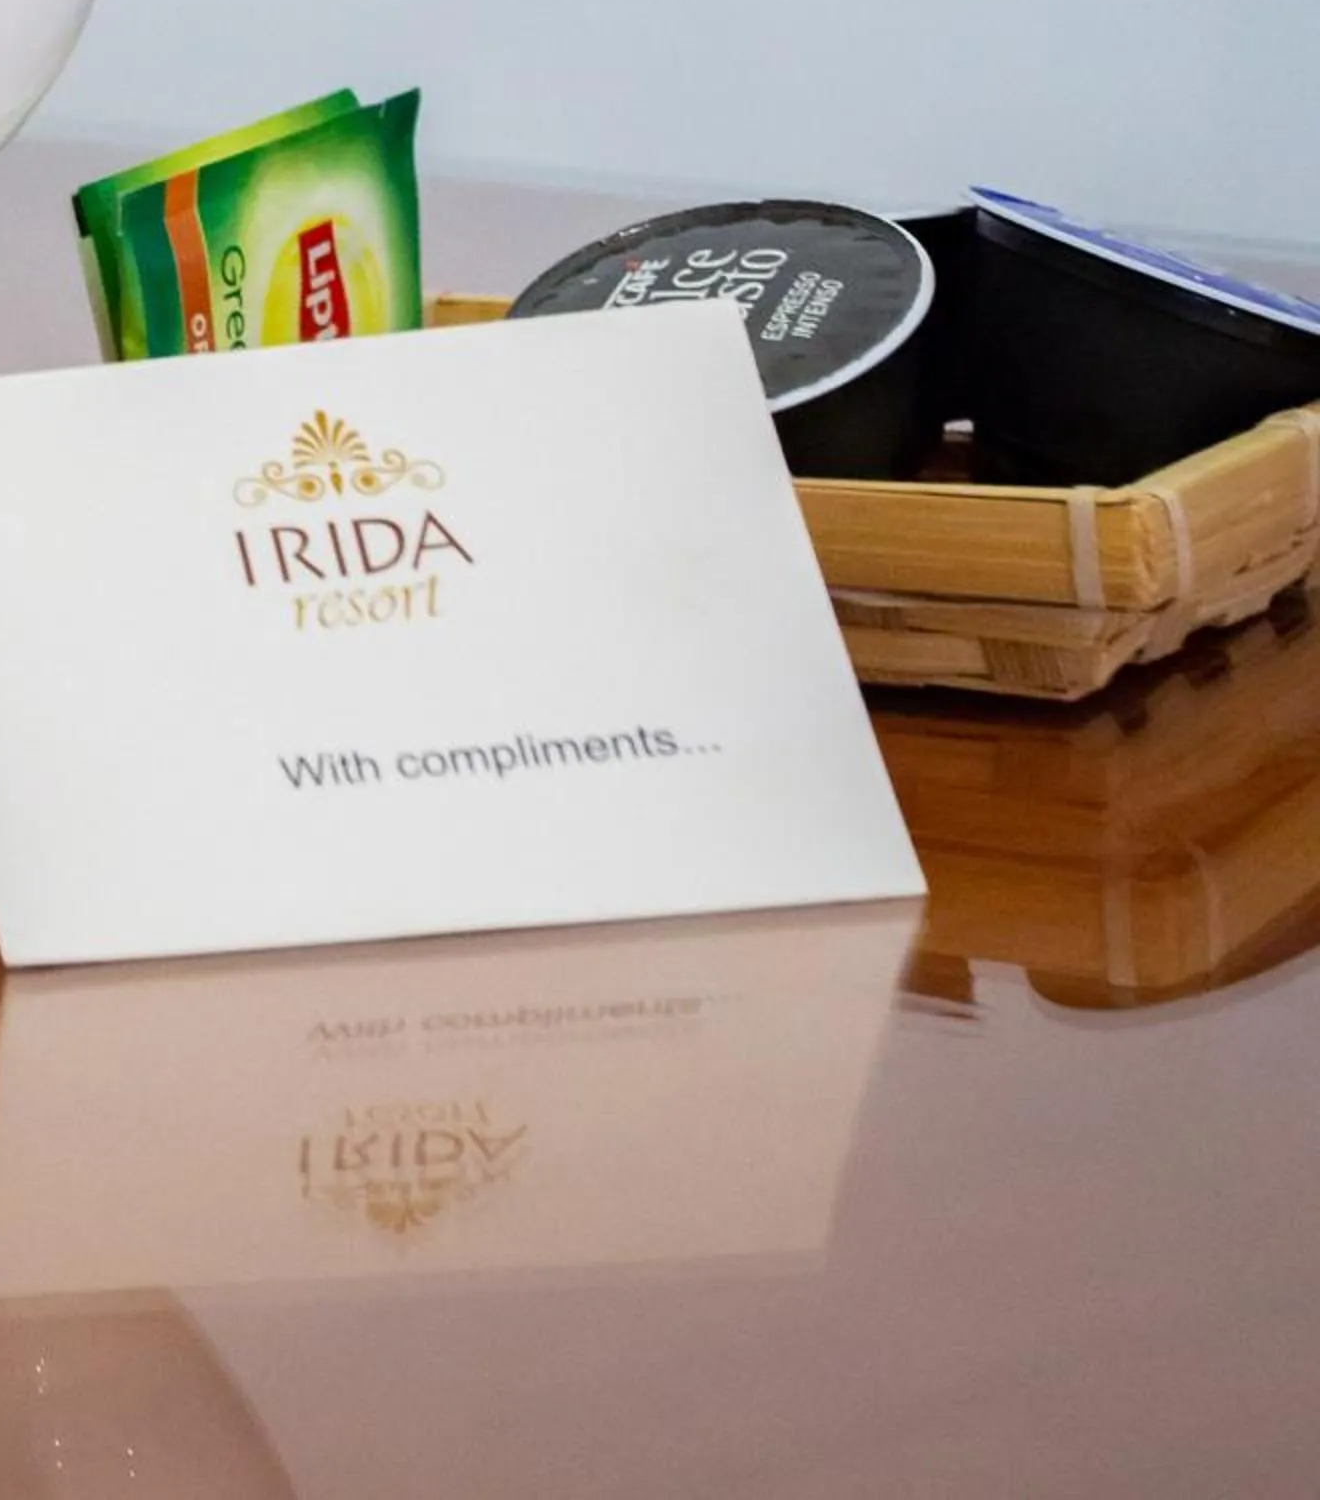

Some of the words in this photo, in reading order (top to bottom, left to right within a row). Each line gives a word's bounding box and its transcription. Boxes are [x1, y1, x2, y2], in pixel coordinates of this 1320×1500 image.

[221, 245, 246, 349] Gre
[306, 240, 339, 341] Lip
[649, 249, 738, 300] lce
[760, 271, 822, 342] ESPRESSO
[791, 279, 844, 340] INTENSO
[235, 511, 474, 587] IRIDA
[293, 575, 441, 631] resort
[279, 751, 381, 790] With
[396, 725, 723, 779] compliments...
